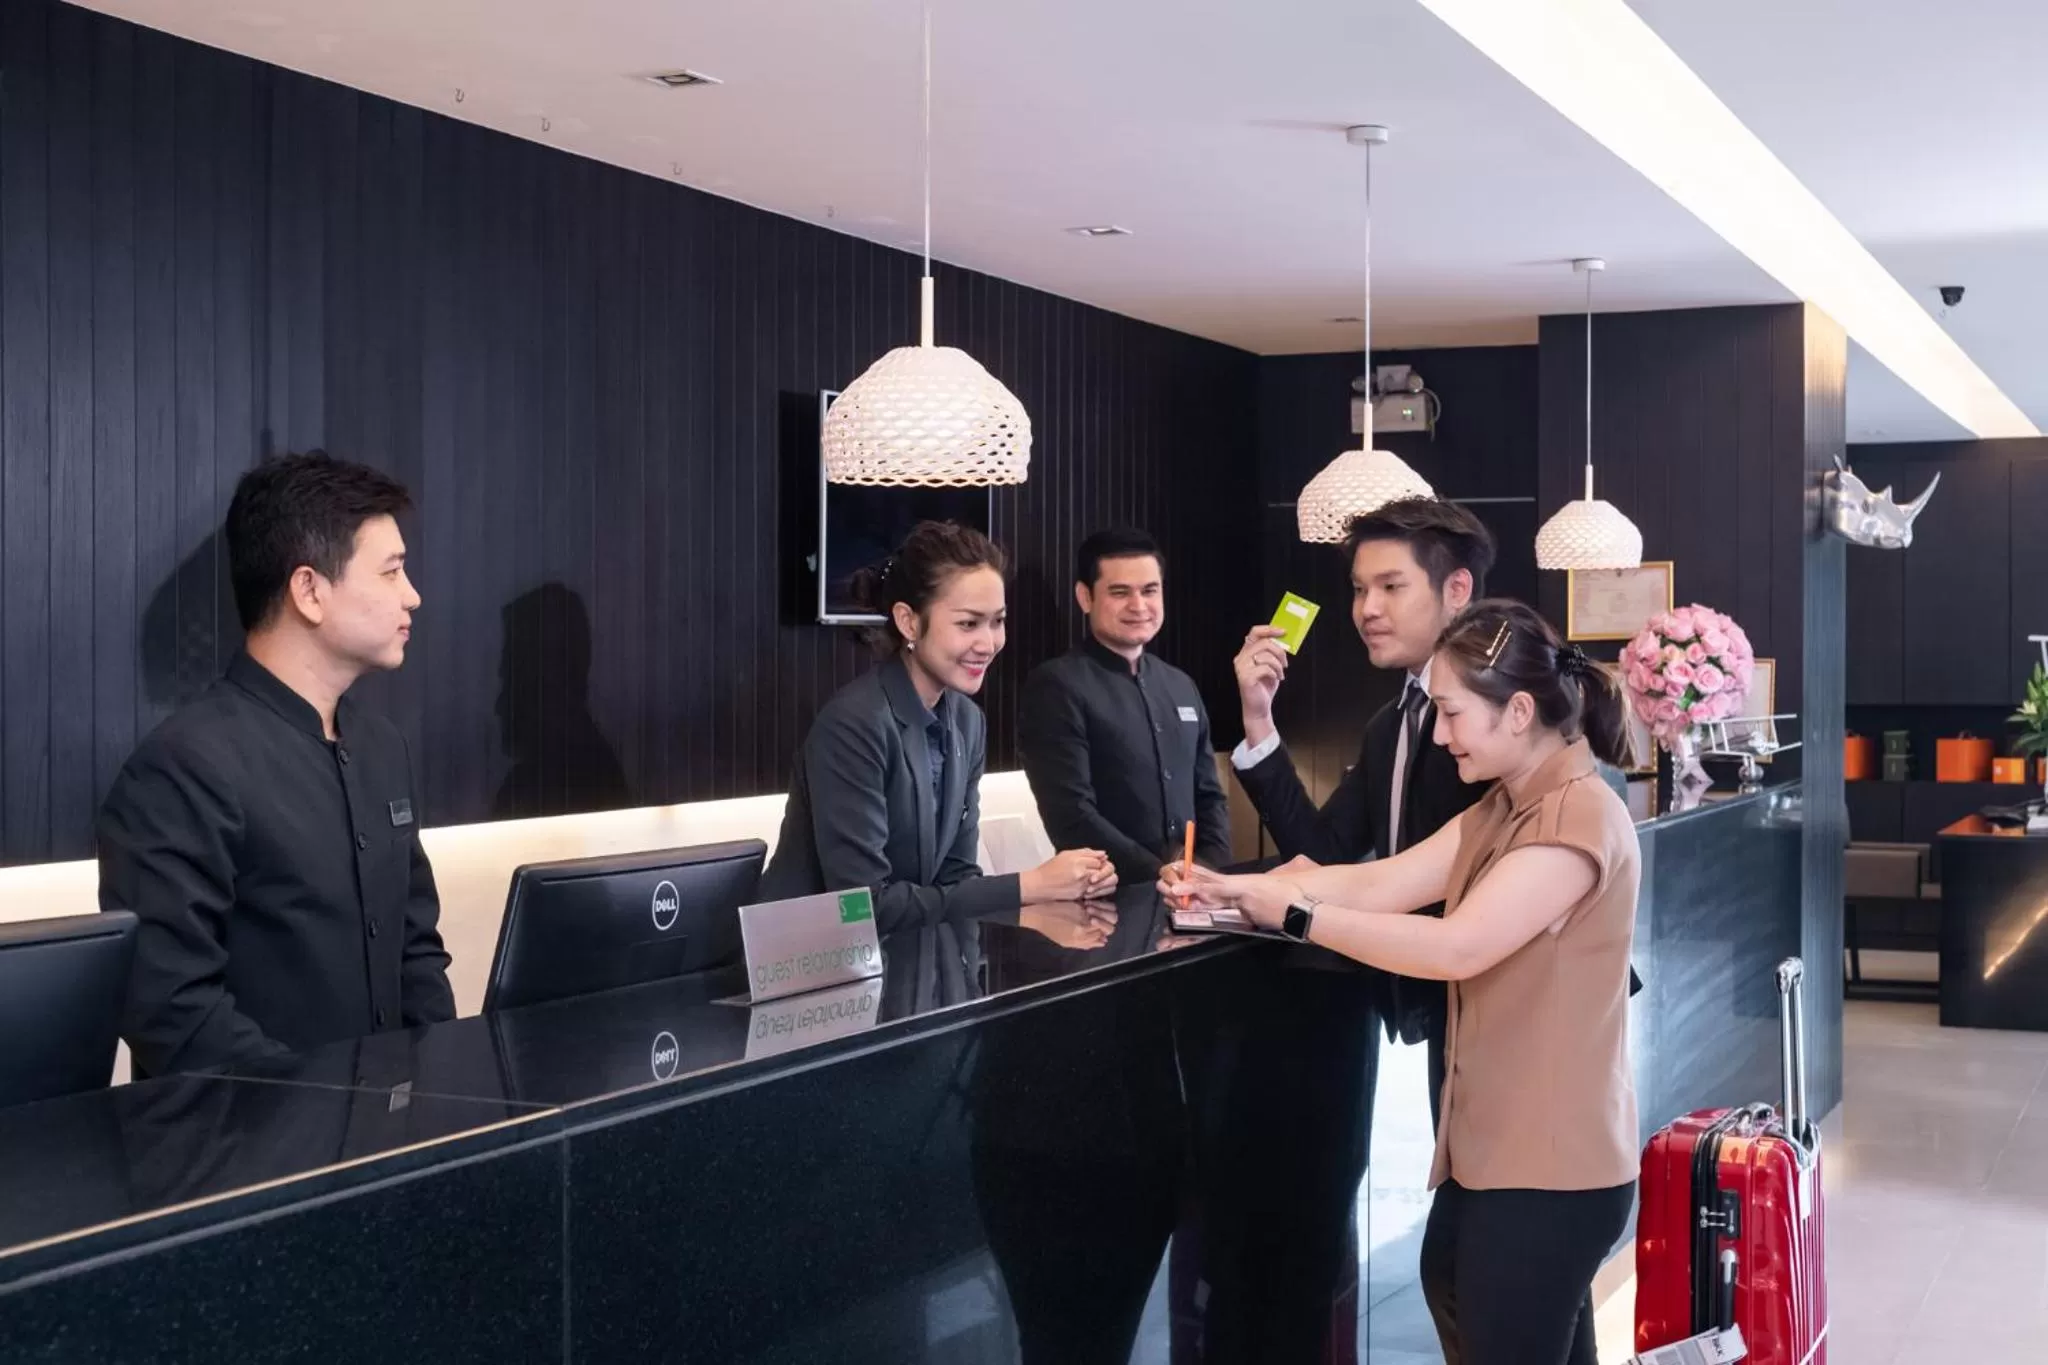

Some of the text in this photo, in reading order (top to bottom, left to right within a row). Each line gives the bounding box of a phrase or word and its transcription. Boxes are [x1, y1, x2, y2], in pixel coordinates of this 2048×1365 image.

[655, 898, 676, 912] DELL
[757, 938, 873, 990] guest relationship
